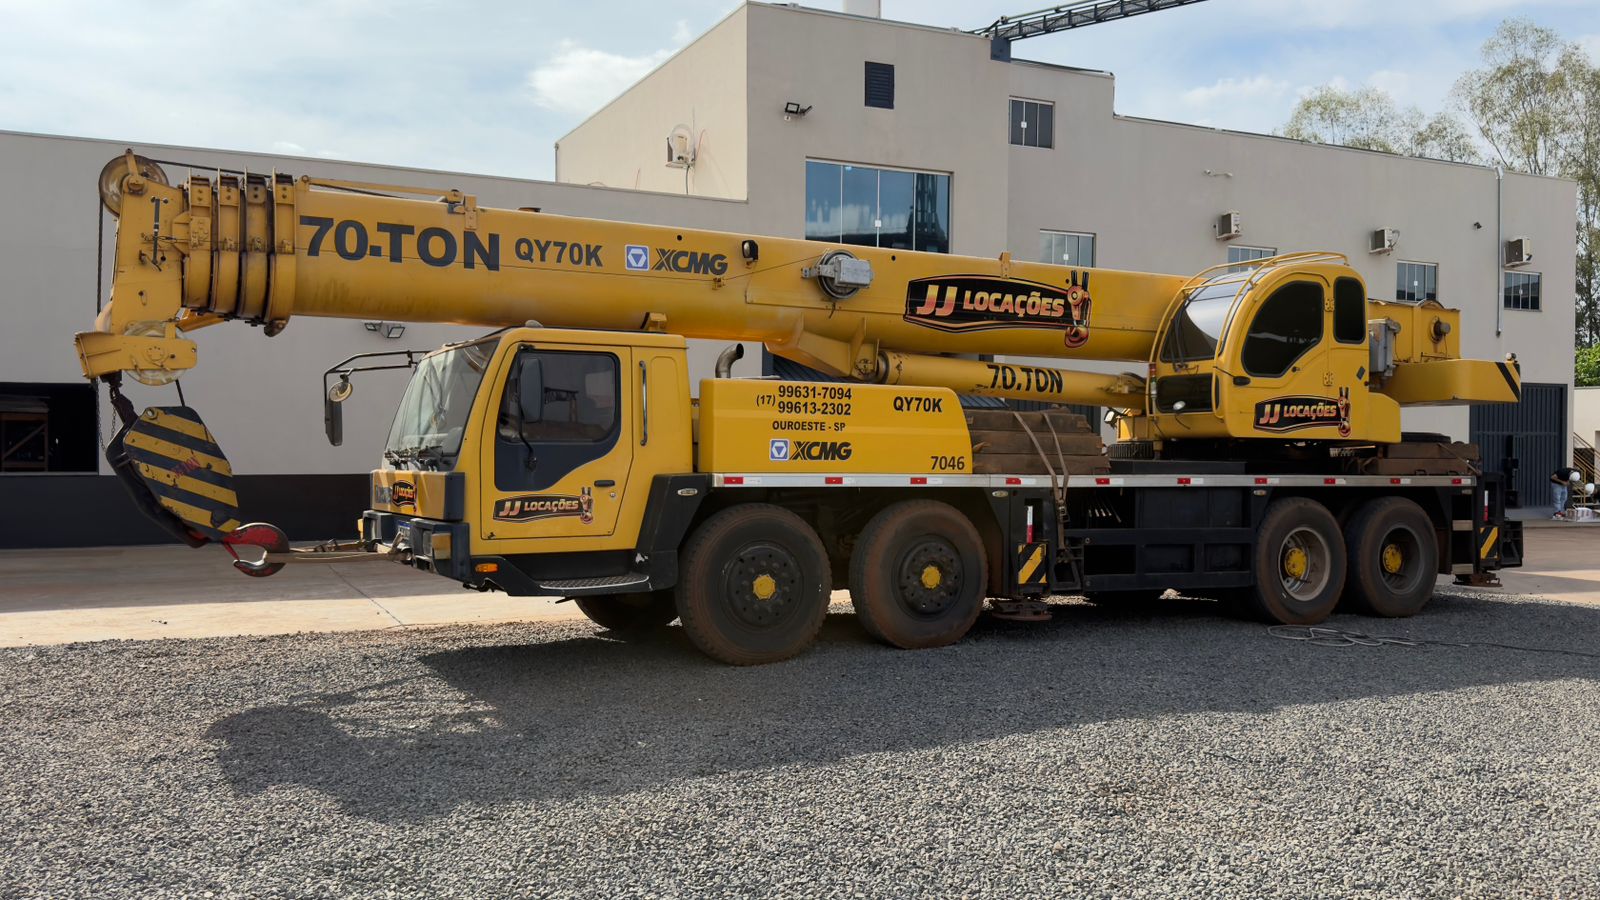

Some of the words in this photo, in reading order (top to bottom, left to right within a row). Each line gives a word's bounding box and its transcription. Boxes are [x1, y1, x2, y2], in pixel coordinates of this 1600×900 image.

[300, 215, 500, 272] 70.TON
[514, 237, 604, 268] QY70K
[652, 248, 728, 276] XCMG
[916, 284, 958, 317] JJ
[962, 290, 1065, 318] LOCAÇÕES
[987, 364, 1064, 394] 70.TON
[756, 395, 776, 407] (17)
[778, 385, 852, 400] 99631-7094
[778, 401, 851, 416] 99613-2302
[893, 396, 943, 413] QY70K
[1259, 404, 1281, 424] JJ
[1283, 402, 1338, 420] LOCAÇÕES
[772, 420, 826, 431] OUROESTE
[834, 422, 846, 431] SP
[790, 441, 852, 461] XCMG
[930, 455, 965, 470] 7046
[499, 500, 521, 516] JJ
[524, 499, 579, 512] LOCAÇÕES
